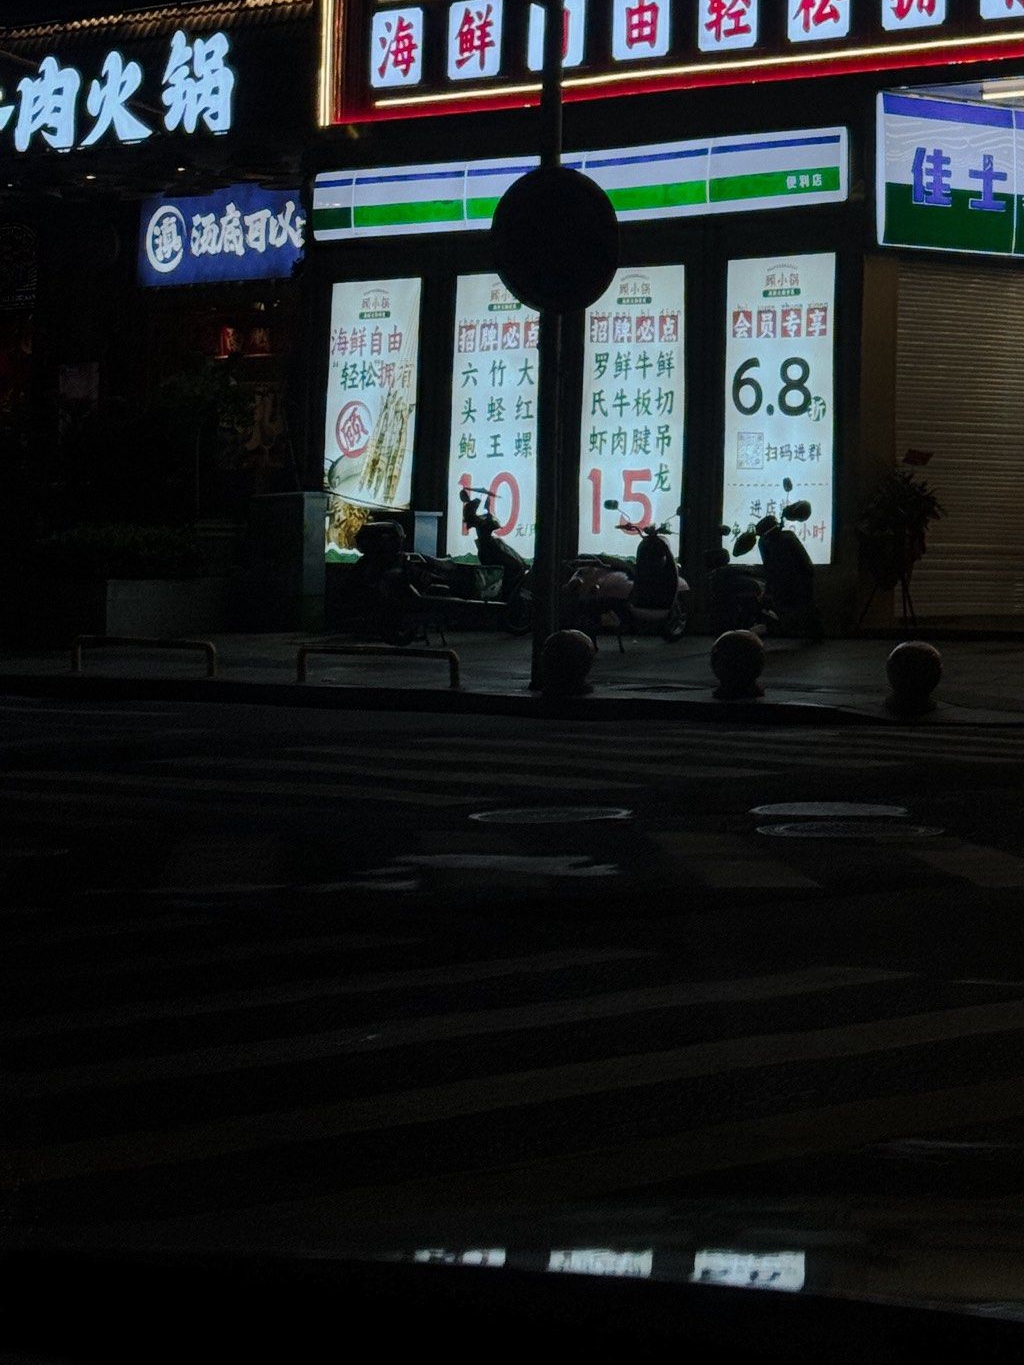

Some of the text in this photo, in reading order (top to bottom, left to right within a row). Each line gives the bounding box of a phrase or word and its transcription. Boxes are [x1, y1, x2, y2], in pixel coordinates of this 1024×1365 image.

[786, 173, 822, 189] 便利店
[589, 316, 679, 343] 招牌必点
[733, 307, 828, 338] 会员专享
[331, 325, 404, 357] 海鲜自由
[458, 323, 540, 353] 招牌必点
[765, 443, 822, 462] 扫码进群
[588, 468, 653, 535] 15
